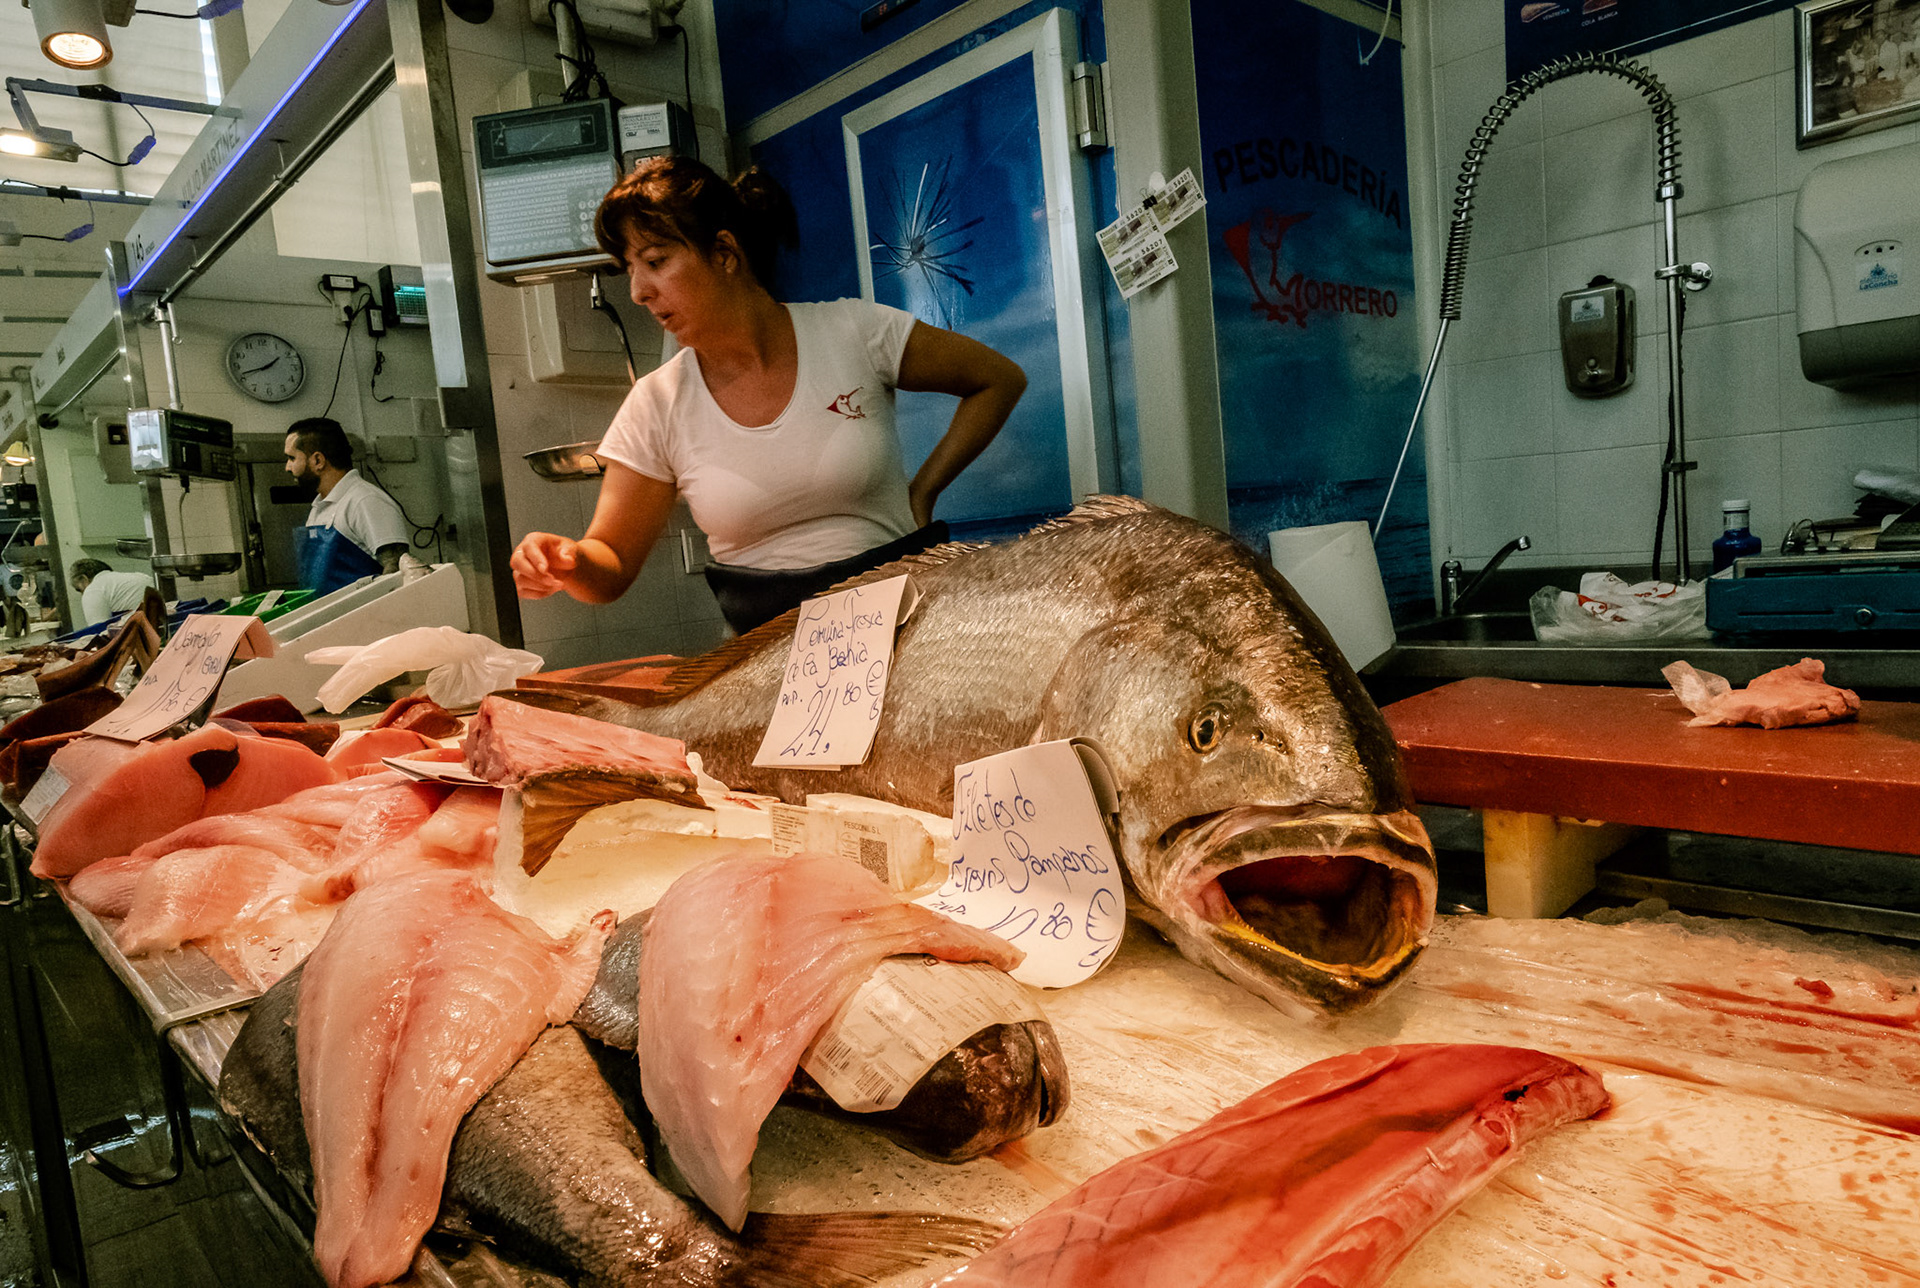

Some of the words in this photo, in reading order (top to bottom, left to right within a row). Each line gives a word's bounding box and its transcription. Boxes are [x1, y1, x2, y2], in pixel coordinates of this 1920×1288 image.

[1581, 19, 1596, 27] COLA
[1598, 11, 1619, 21] BLANCA
[1141, 238, 1163, 255] 56207
